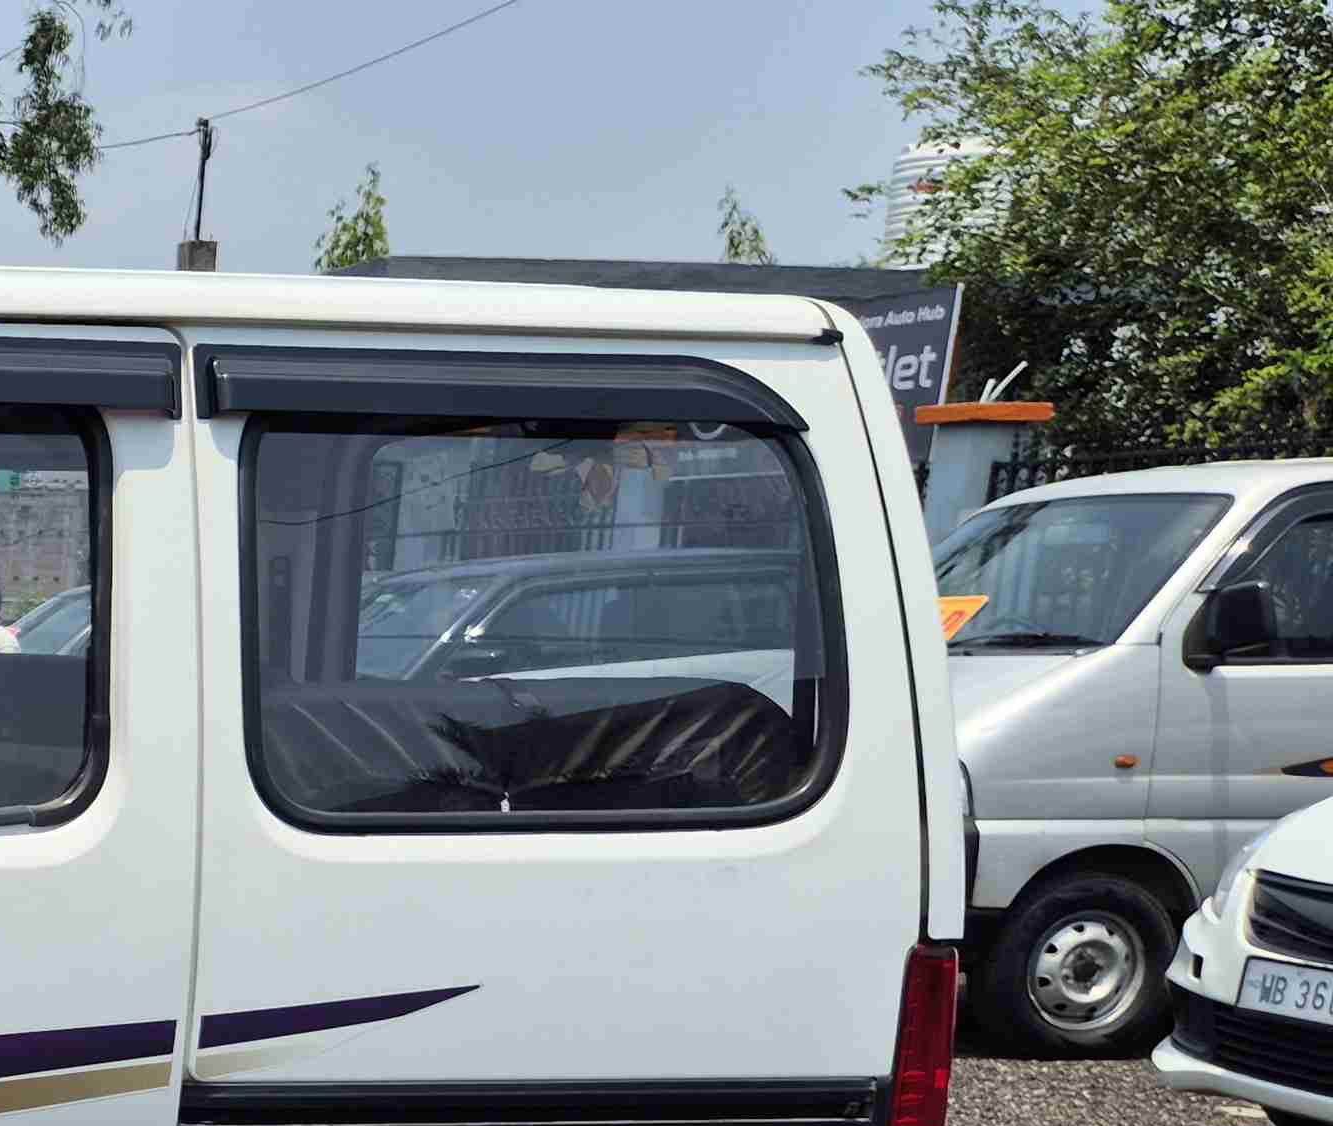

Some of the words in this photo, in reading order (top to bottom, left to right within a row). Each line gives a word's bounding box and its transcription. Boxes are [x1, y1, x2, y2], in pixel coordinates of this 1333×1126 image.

[884, 309, 916, 327] Auto
[916, 304, 946, 323] Hub
[879, 344, 937, 390] let
[1259, 973, 1288, 1005] WB
[1295, 980, 1333, 1015] 36
